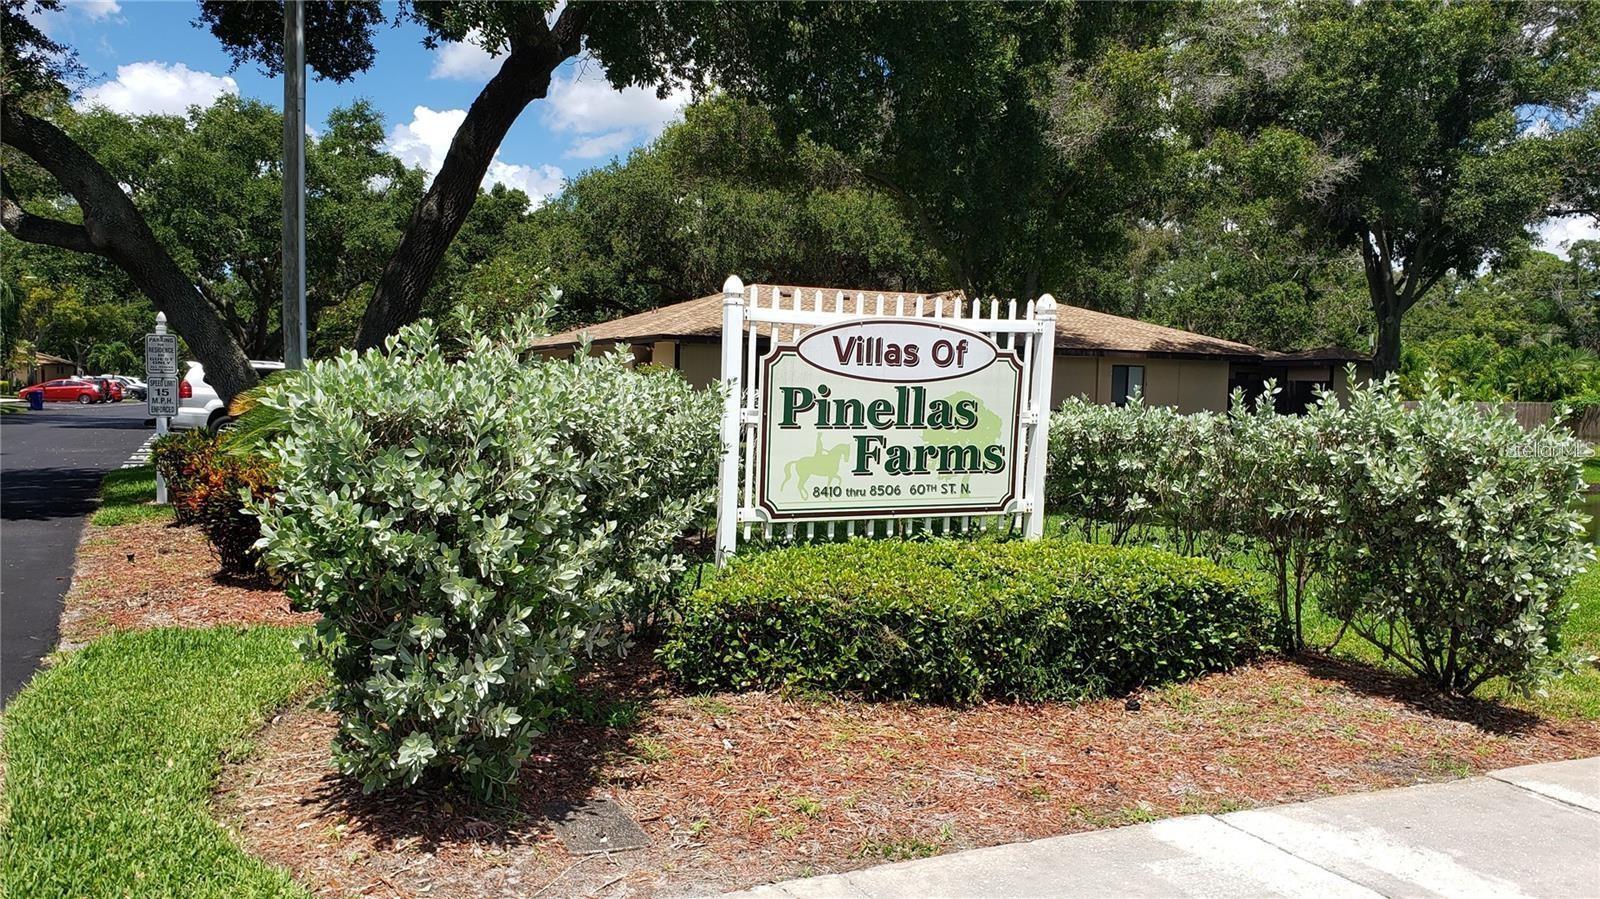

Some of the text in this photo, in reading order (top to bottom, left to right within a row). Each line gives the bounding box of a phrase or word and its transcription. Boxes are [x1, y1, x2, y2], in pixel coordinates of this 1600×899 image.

[832, 335, 969, 368] Villas Of
[155, 388, 170, 396] 15
[778, 384, 978, 430] Pinellas
[851, 434, 1006, 476] Farms
[812, 483, 971, 498] 8410 thru 8506 60TH ST. N.
